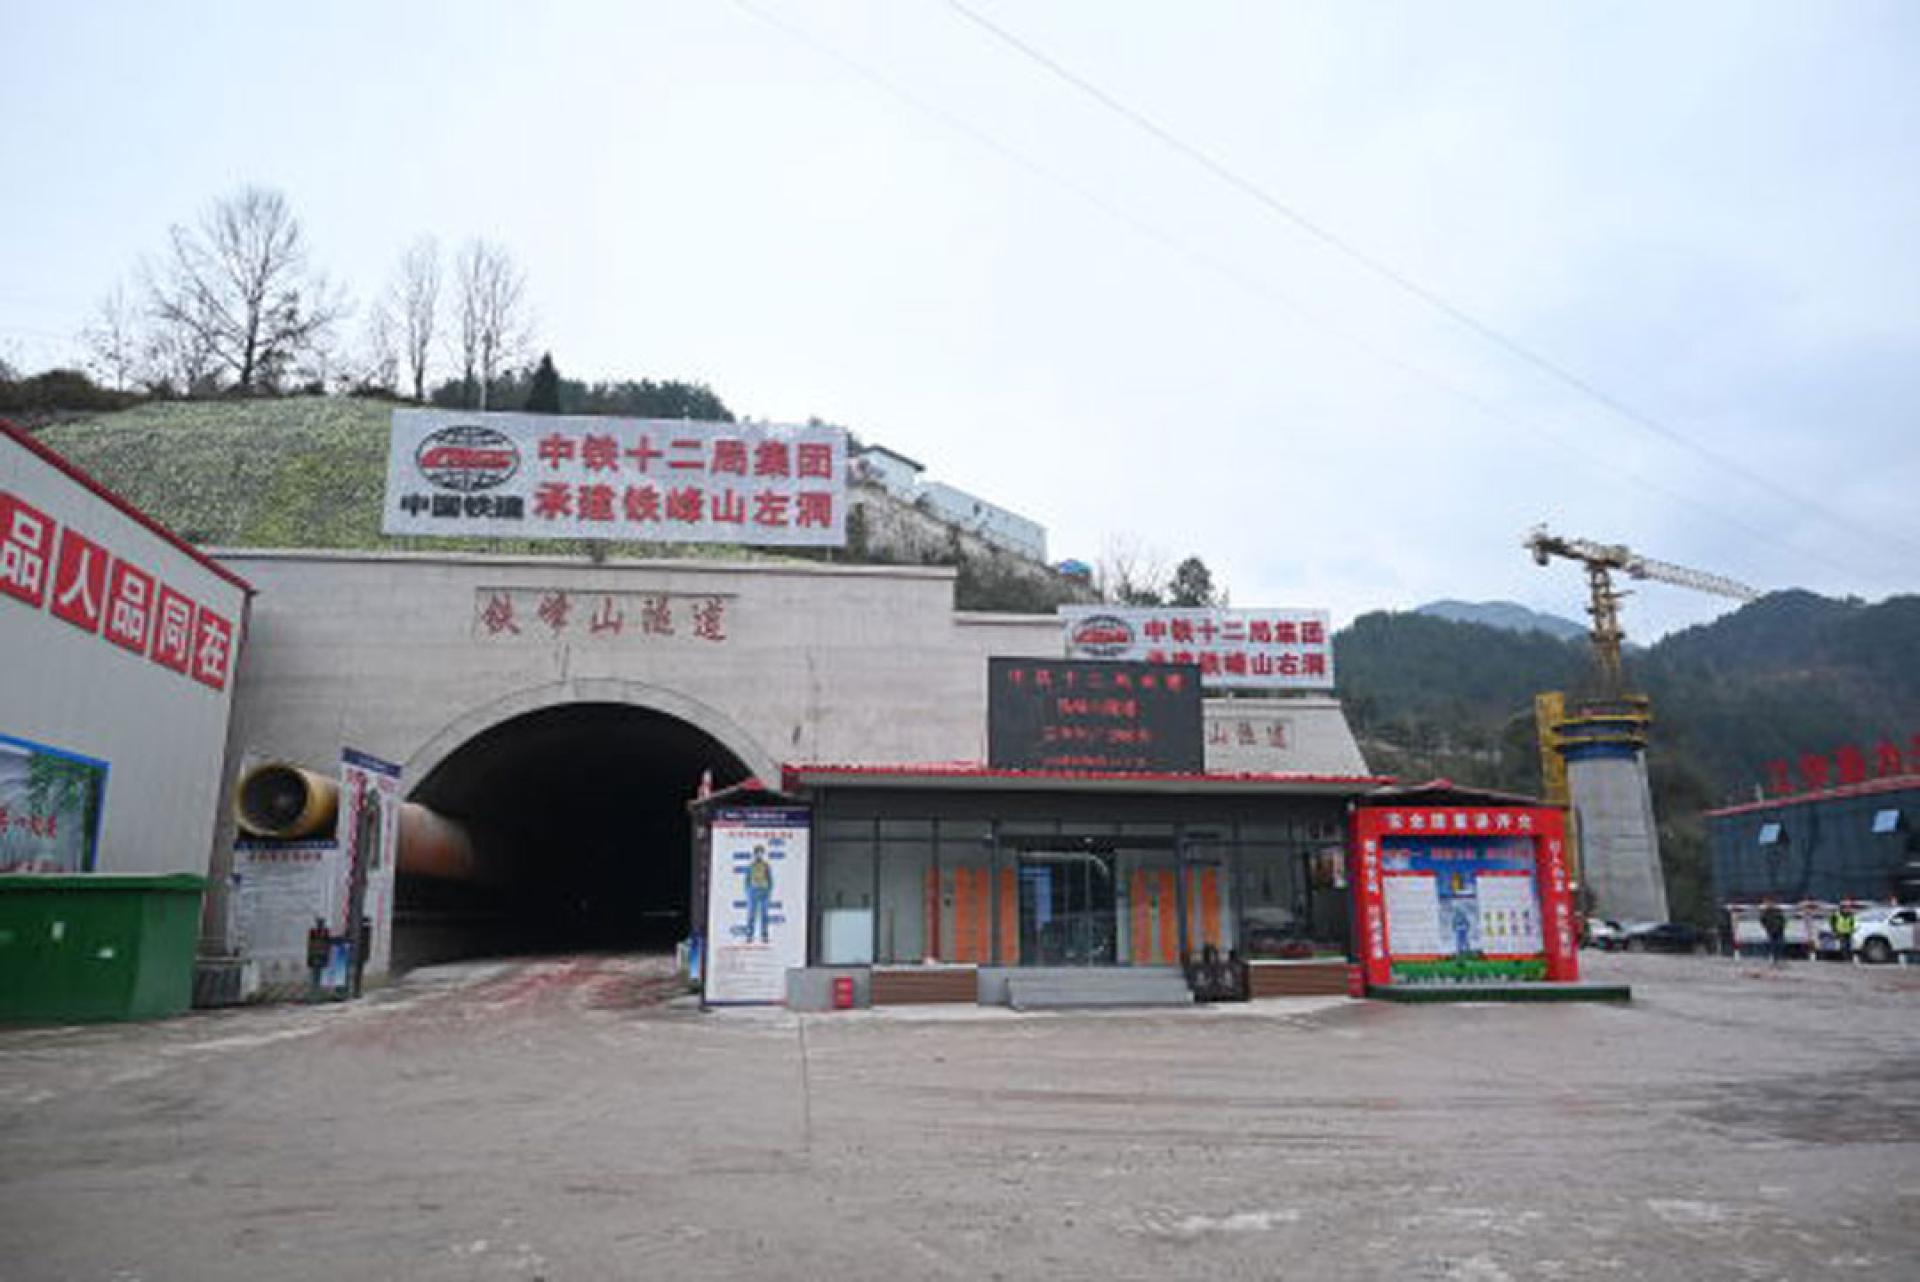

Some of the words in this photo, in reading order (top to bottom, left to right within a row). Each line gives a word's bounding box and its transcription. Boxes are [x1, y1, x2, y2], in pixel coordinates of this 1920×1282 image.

[538, 432, 832, 479] 中铁十二局集团
[400, 491, 524, 518] 中国铁建
[533, 481, 832, 528] 承建铁峰山左洞
[0, 510, 228, 679] 品人品同在
[1144, 617, 1324, 646] 中铁十二局集团
